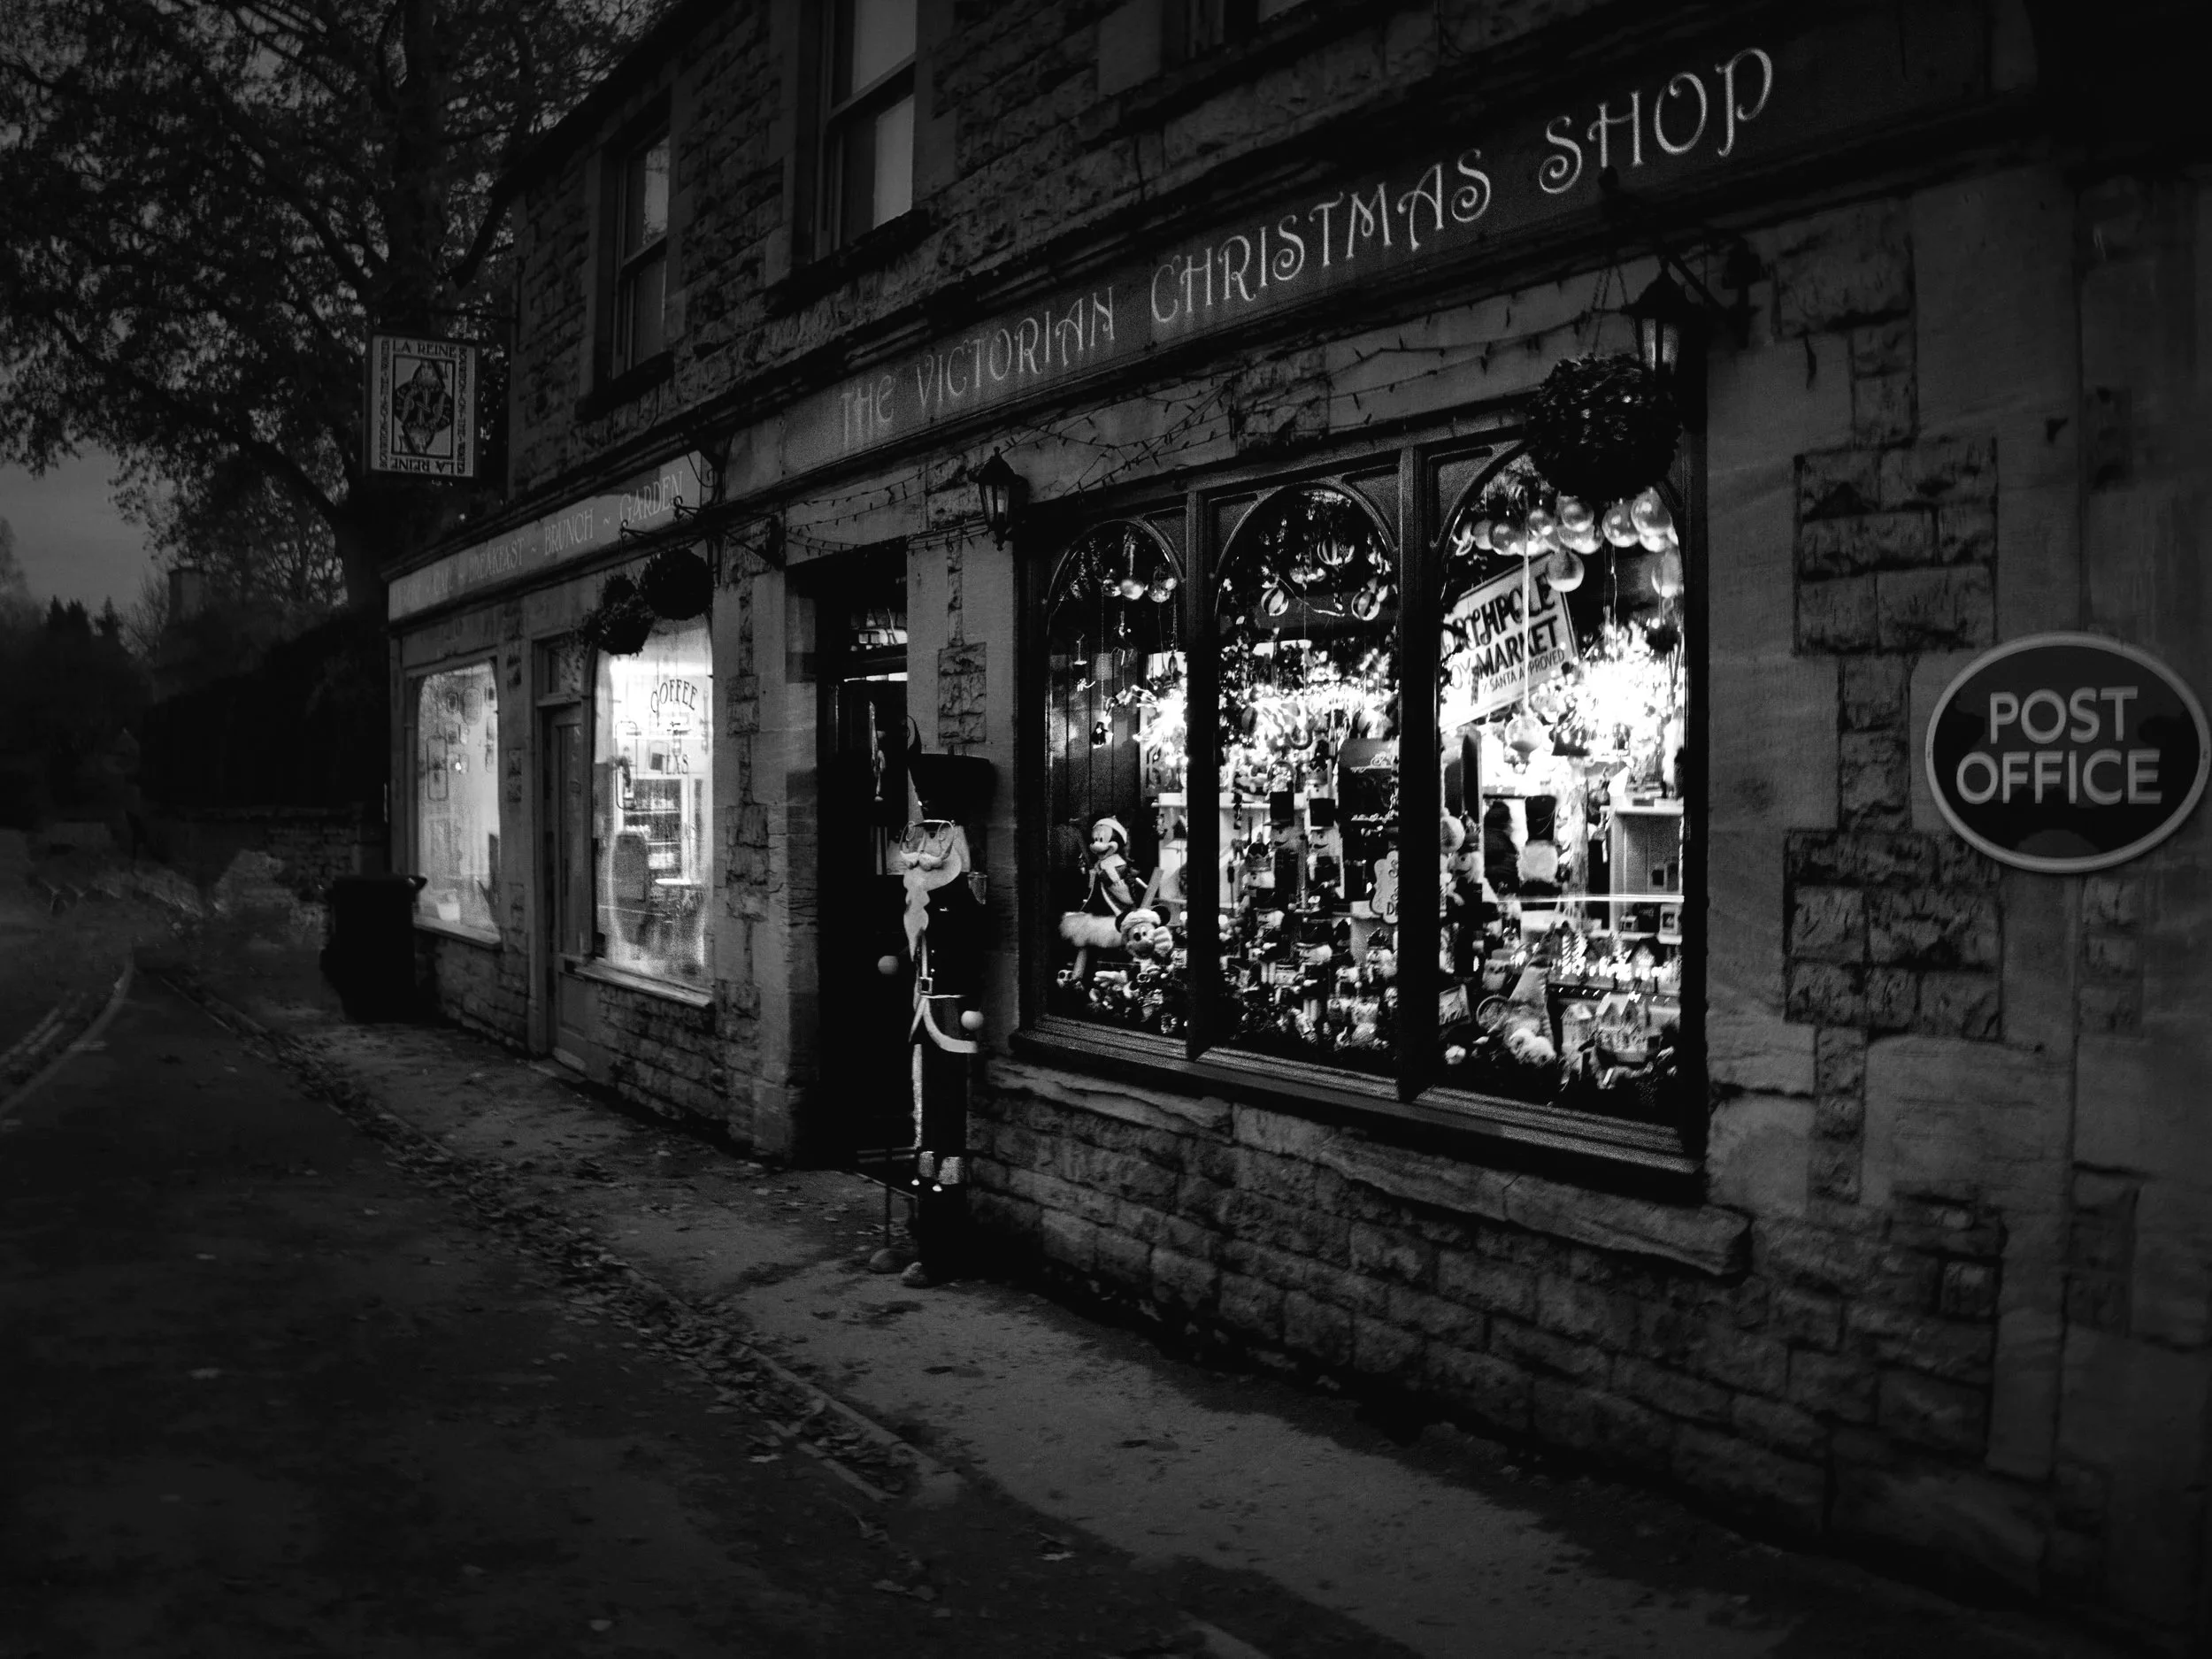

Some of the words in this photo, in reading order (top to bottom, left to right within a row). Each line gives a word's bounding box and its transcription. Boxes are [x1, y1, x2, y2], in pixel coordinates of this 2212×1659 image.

[838, 379, 895, 448] THE
[917, 285, 1116, 410] VICTORIAN
[1150, 148, 1493, 326] CHRISTMAS
[1537, 45, 1774, 196] SHOP
[393, 340, 411, 354] LA
[418, 343, 457, 358] REINE
[468, 537, 524, 583] BREAKFAST
[544, 509, 594, 557] BRUNCH
[619, 472, 682, 526] GARDEN
[1477, 615, 1557, 680] MARKET
[1489, 670, 1517, 692] SANTA
[1518, 648, 1564, 681] APROVED
[650, 679, 698, 713] COFFEE
[1989, 685, 2139, 745] POST
[1956, 748, 2162, 806] OFFICE
